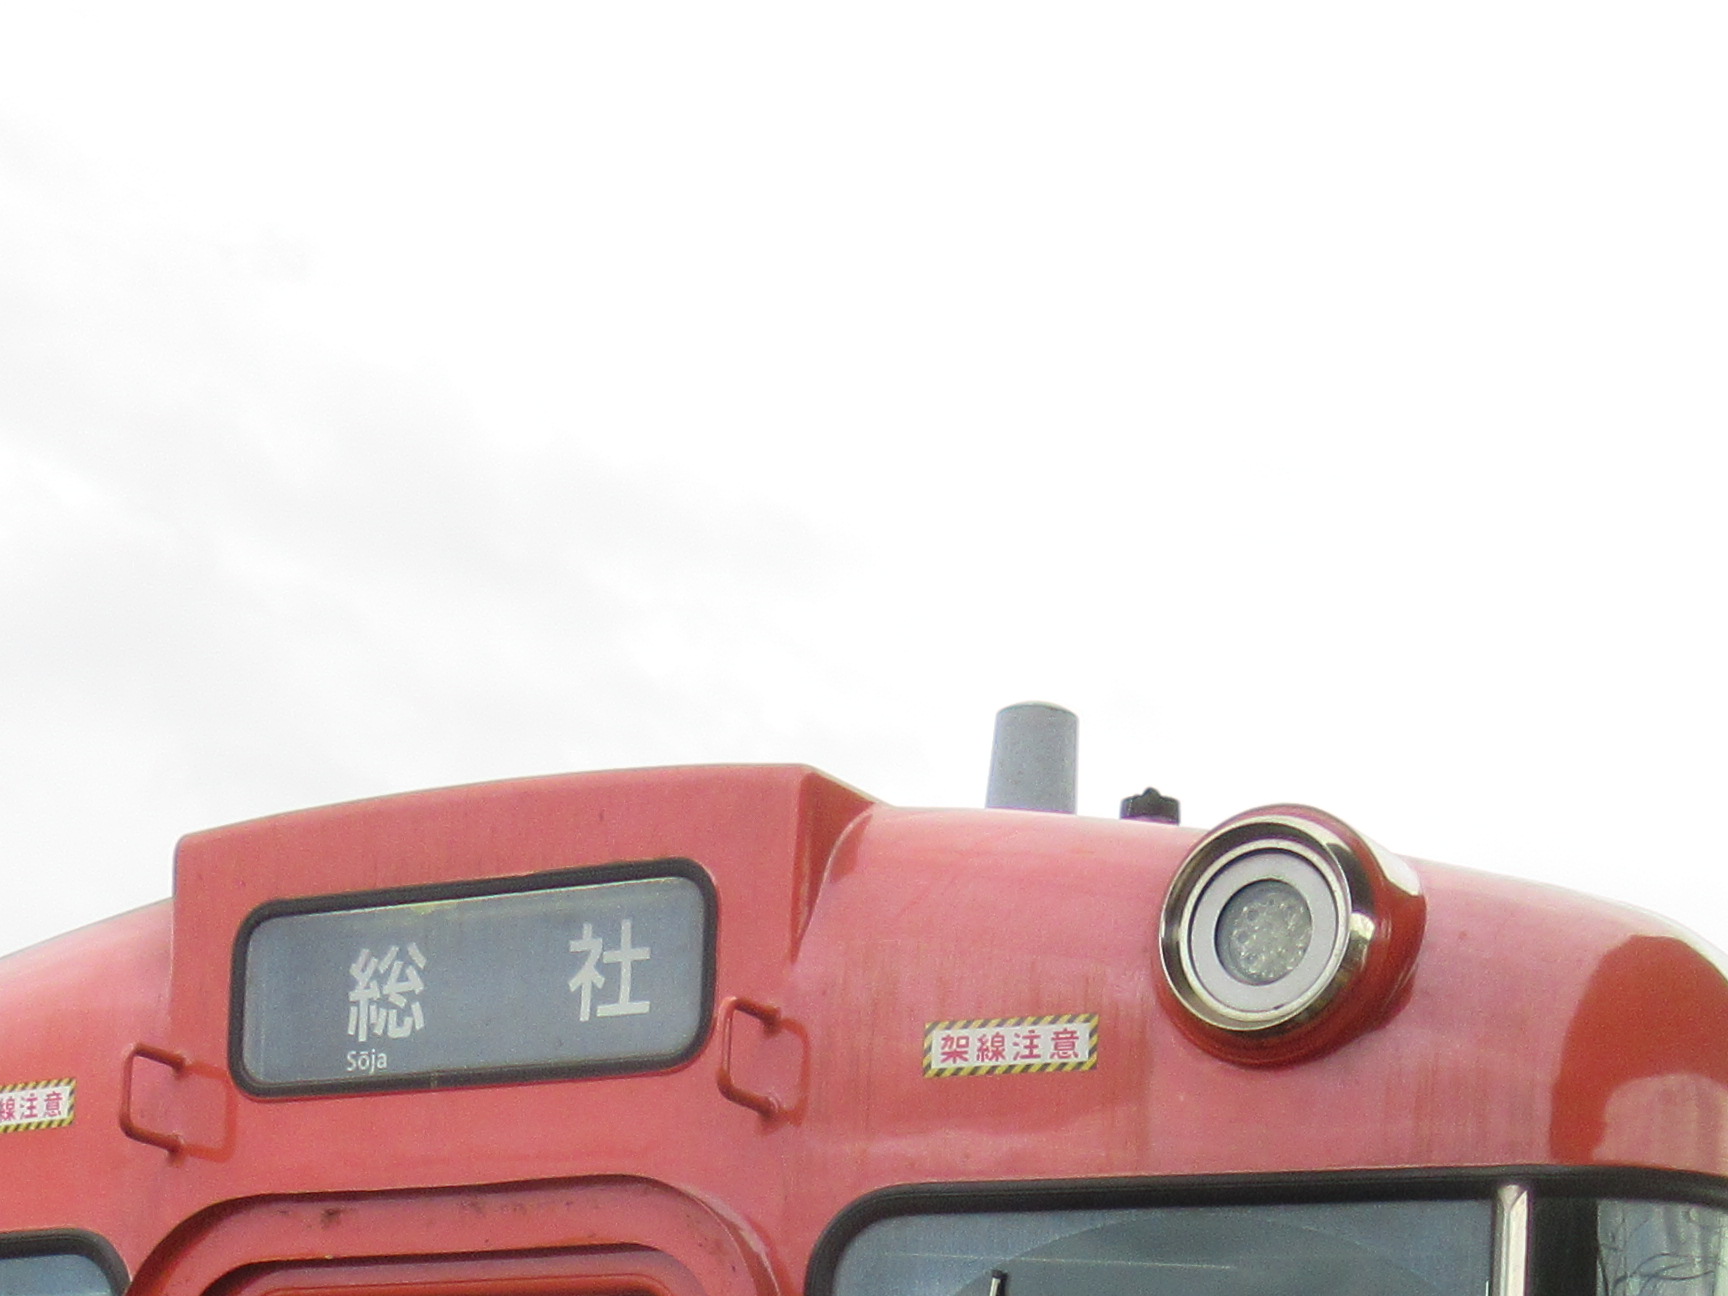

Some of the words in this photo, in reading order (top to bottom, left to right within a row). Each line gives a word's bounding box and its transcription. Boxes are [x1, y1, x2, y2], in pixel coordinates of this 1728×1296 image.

[346, 1047, 388, 1075] Sōja
[939, 1027, 1080, 1065] 架線注意
